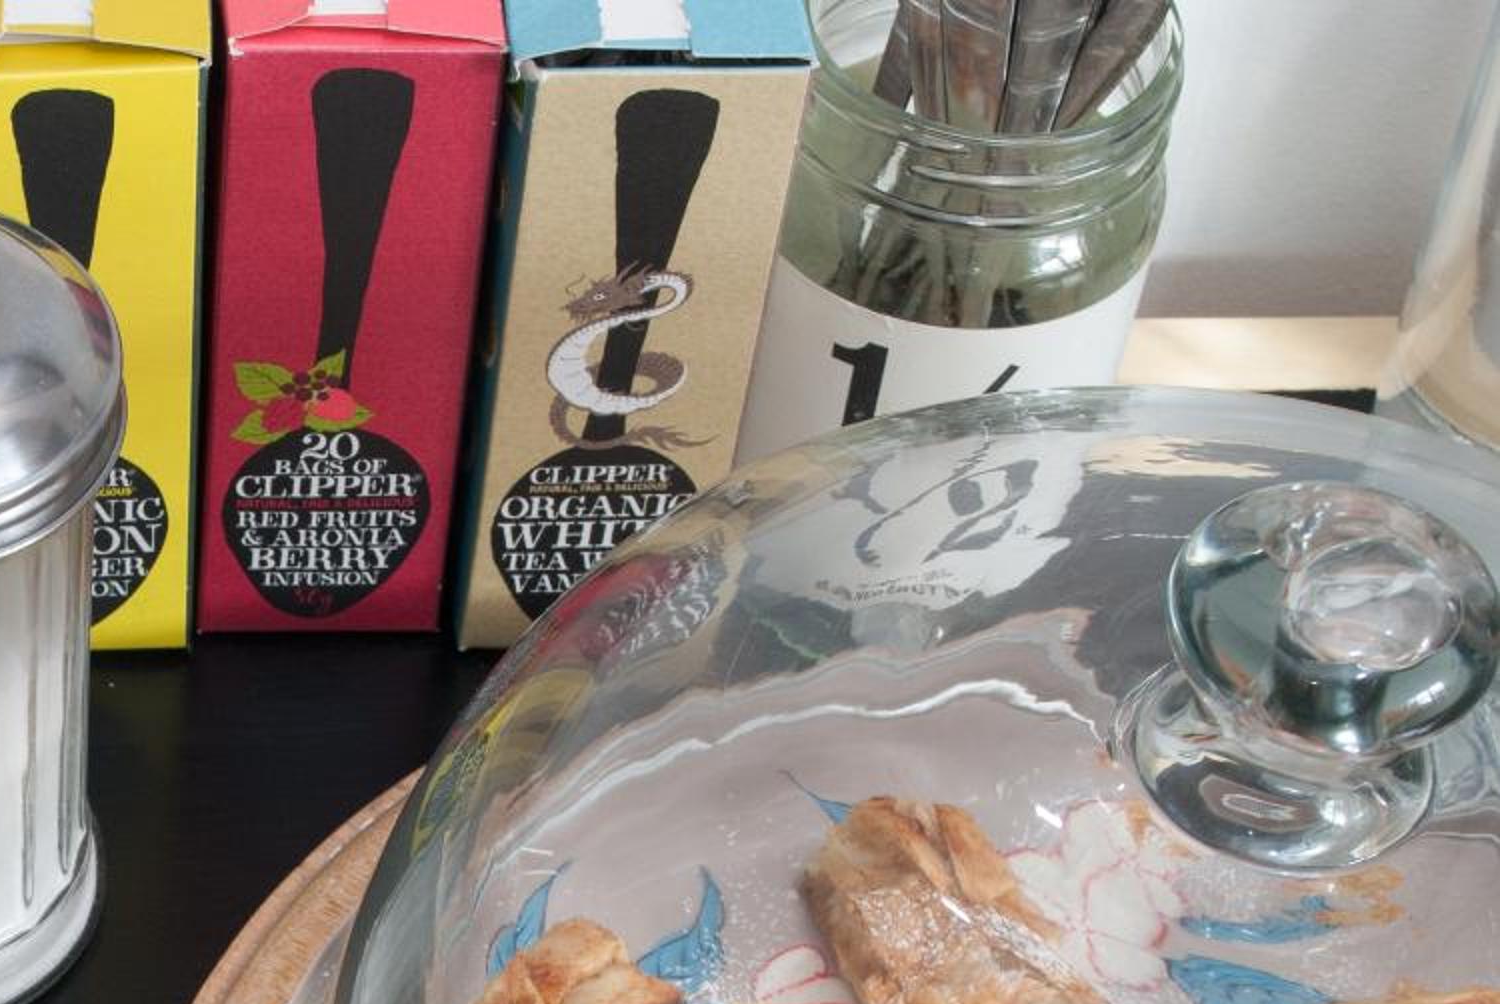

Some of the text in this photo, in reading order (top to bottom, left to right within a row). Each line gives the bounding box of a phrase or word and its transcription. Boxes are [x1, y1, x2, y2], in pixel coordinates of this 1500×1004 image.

[300, 431, 361, 461] 20
[274, 458, 388, 476] BAGS OF
[529, 463, 670, 486] CLIPPER
[235, 473, 418, 499] CLIPPER
[236, 509, 418, 528] RED FRUITS
[241, 527, 407, 548] & ARONIA
[498, 518, 653, 551] WHIT
[247, 545, 396, 571] BERRY
[502, 551, 570, 572] TEA
[262, 570, 380, 587] INFUSION
